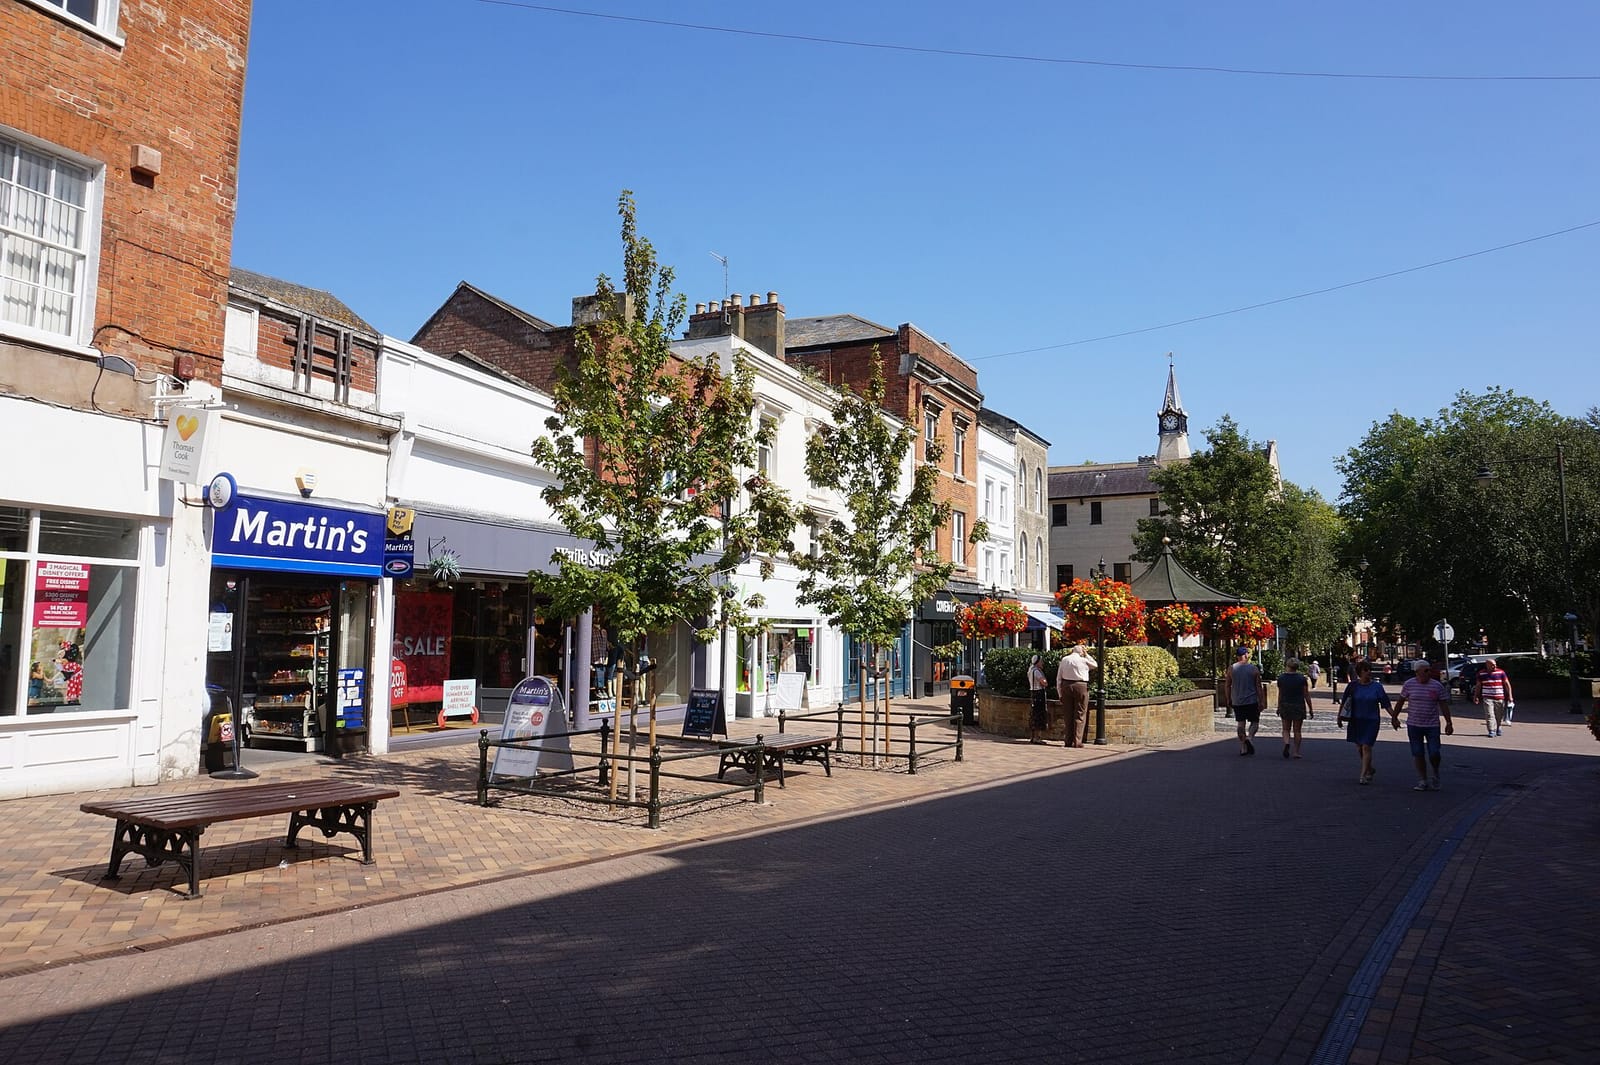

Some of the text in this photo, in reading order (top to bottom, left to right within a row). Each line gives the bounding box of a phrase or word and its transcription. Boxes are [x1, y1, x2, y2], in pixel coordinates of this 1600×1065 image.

[173, 441, 194, 453] Thomas
[174, 451, 189, 461] Cook
[230, 508, 368, 553] Martin's
[385, 543, 414, 551] Martin's
[404, 636, 446, 656] SALE
[392, 672, 406, 688] 20%
[394, 687, 404, 698] OFF
[519, 686, 549, 695] Martin's
